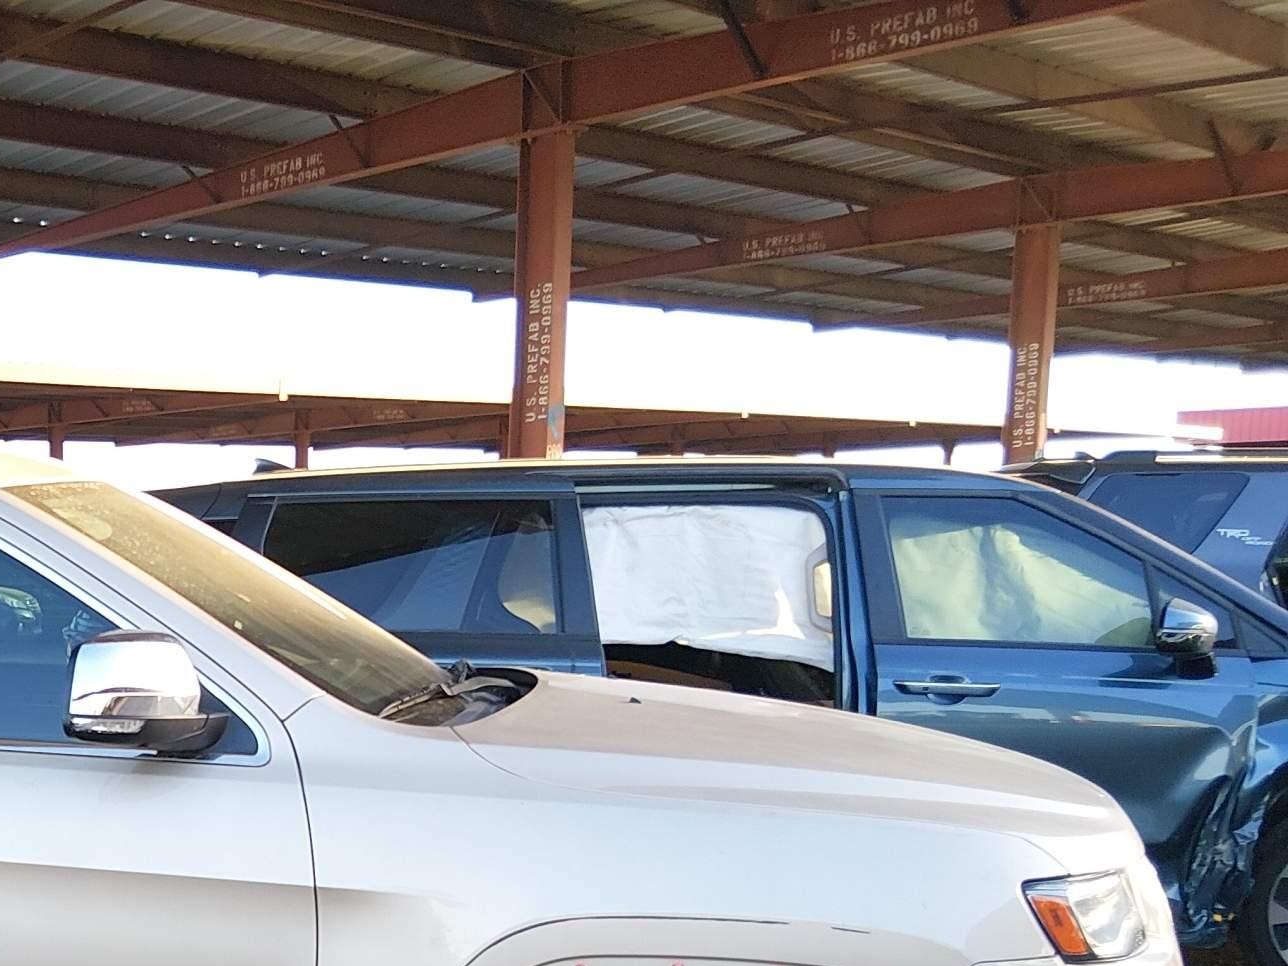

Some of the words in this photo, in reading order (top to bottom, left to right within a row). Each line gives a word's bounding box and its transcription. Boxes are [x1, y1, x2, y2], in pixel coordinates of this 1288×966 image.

[870, 7, 938, 37] PREFAB
[263, 157, 303, 177] PREFAB
[530, 283, 541, 315] INC.
[527, 321, 540, 384] PREFAB
[538, 282, 553, 420] 1-866-799-0969
[525, 391, 536, 423] U.S.
[1014, 371, 1026, 419] PREFAB
